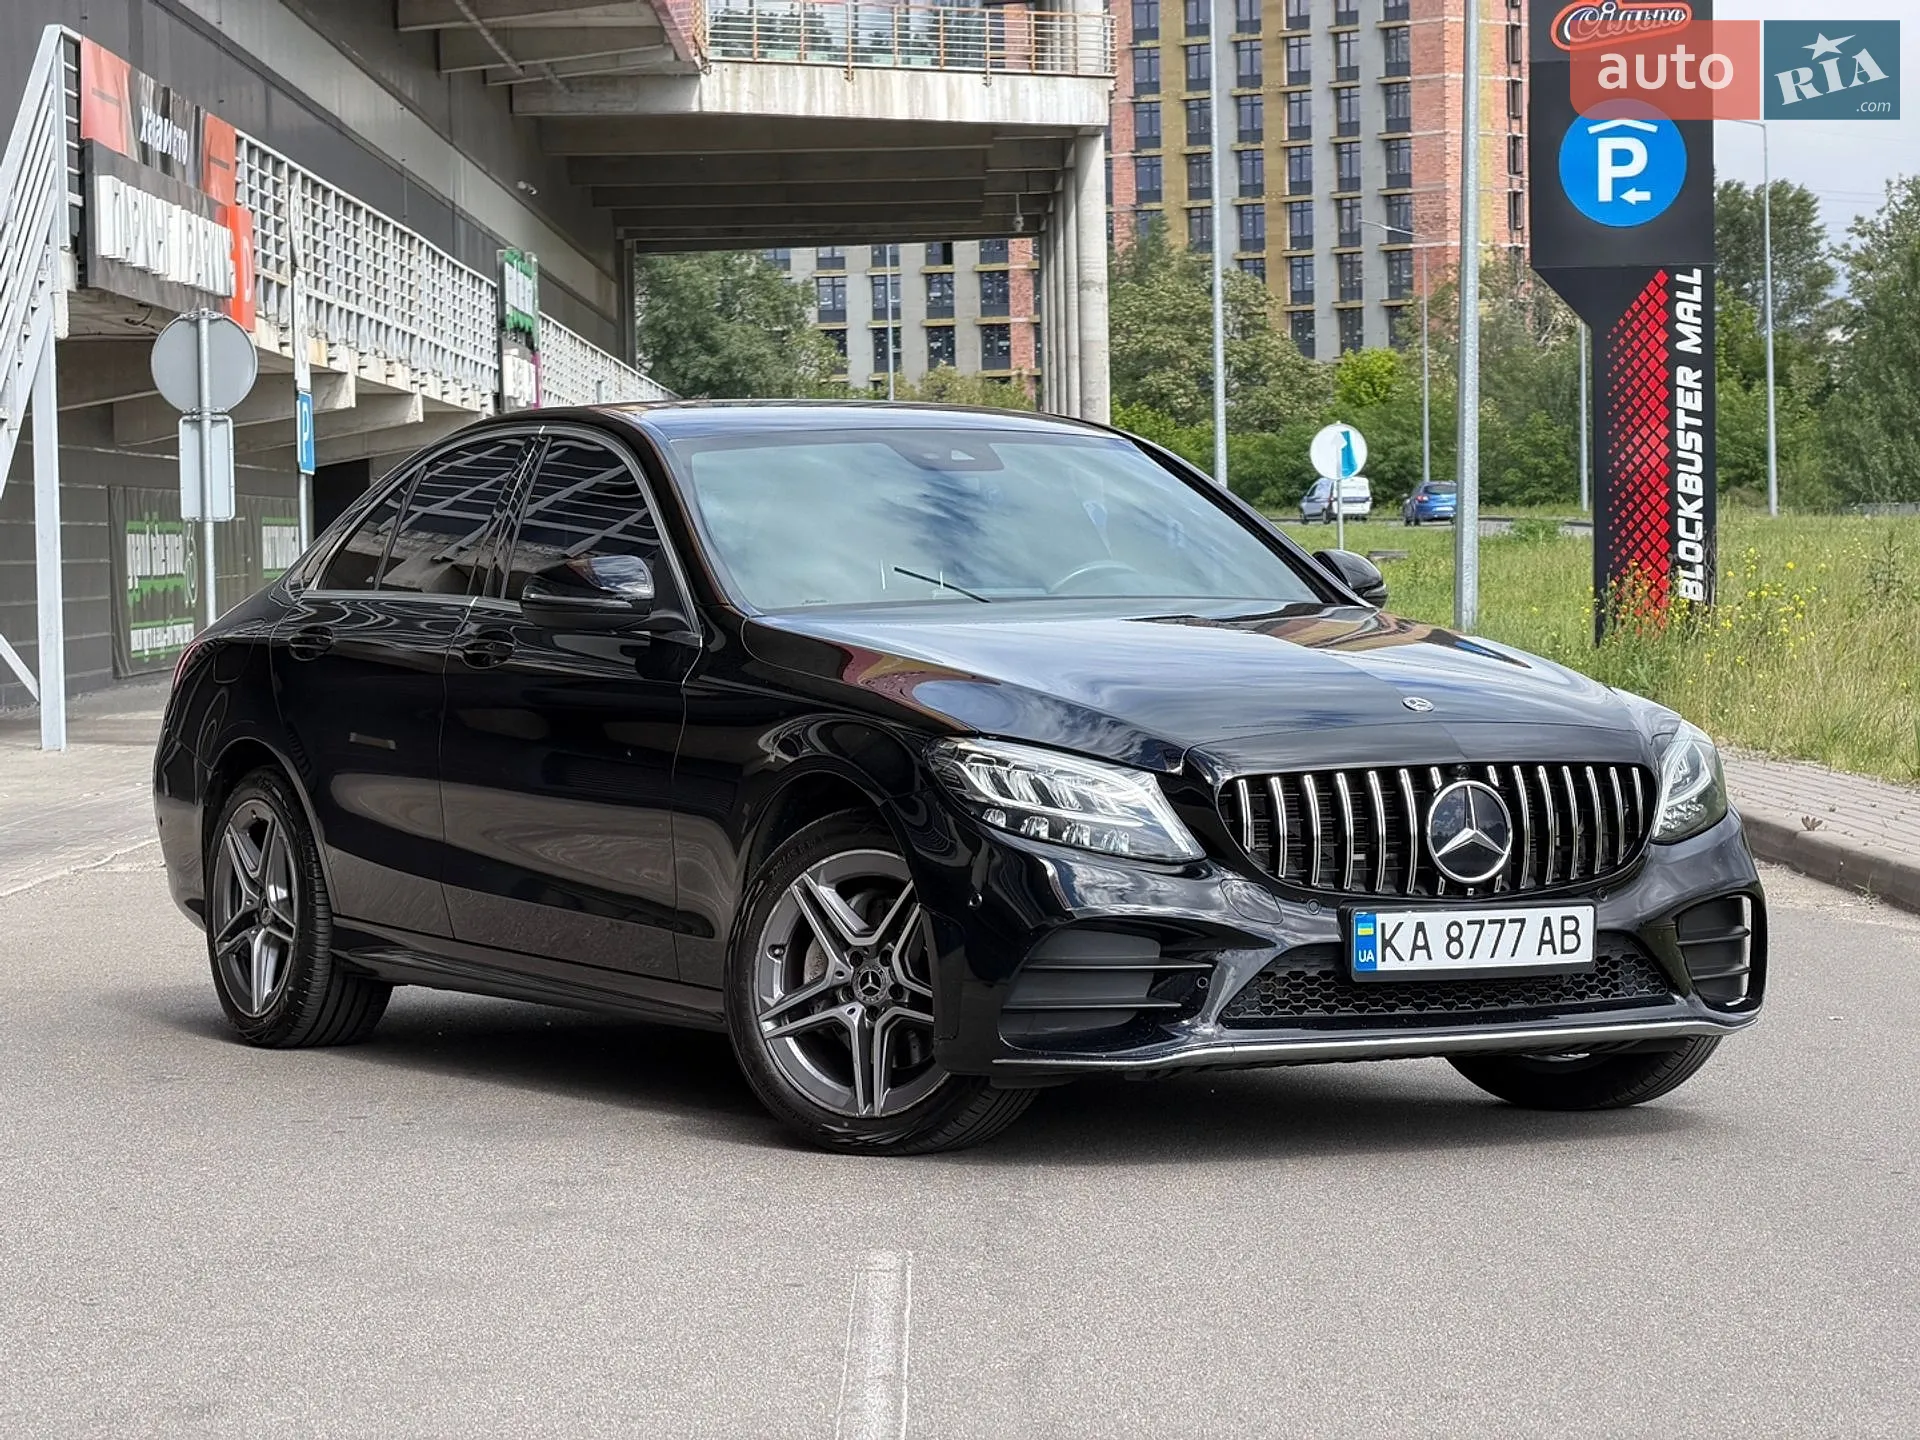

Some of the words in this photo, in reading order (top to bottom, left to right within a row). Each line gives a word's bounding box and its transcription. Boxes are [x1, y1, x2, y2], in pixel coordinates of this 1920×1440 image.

[1597, 137, 1648, 202] P
[1675, 268, 1703, 355] MALL
[1676, 365, 1704, 601] BLOCKBUSTER
[1358, 949, 1375, 963] UA
[1380, 920, 1433, 962] KA
[1445, 916, 1527, 960] 8777
[1536, 914, 1582, 957] AB
